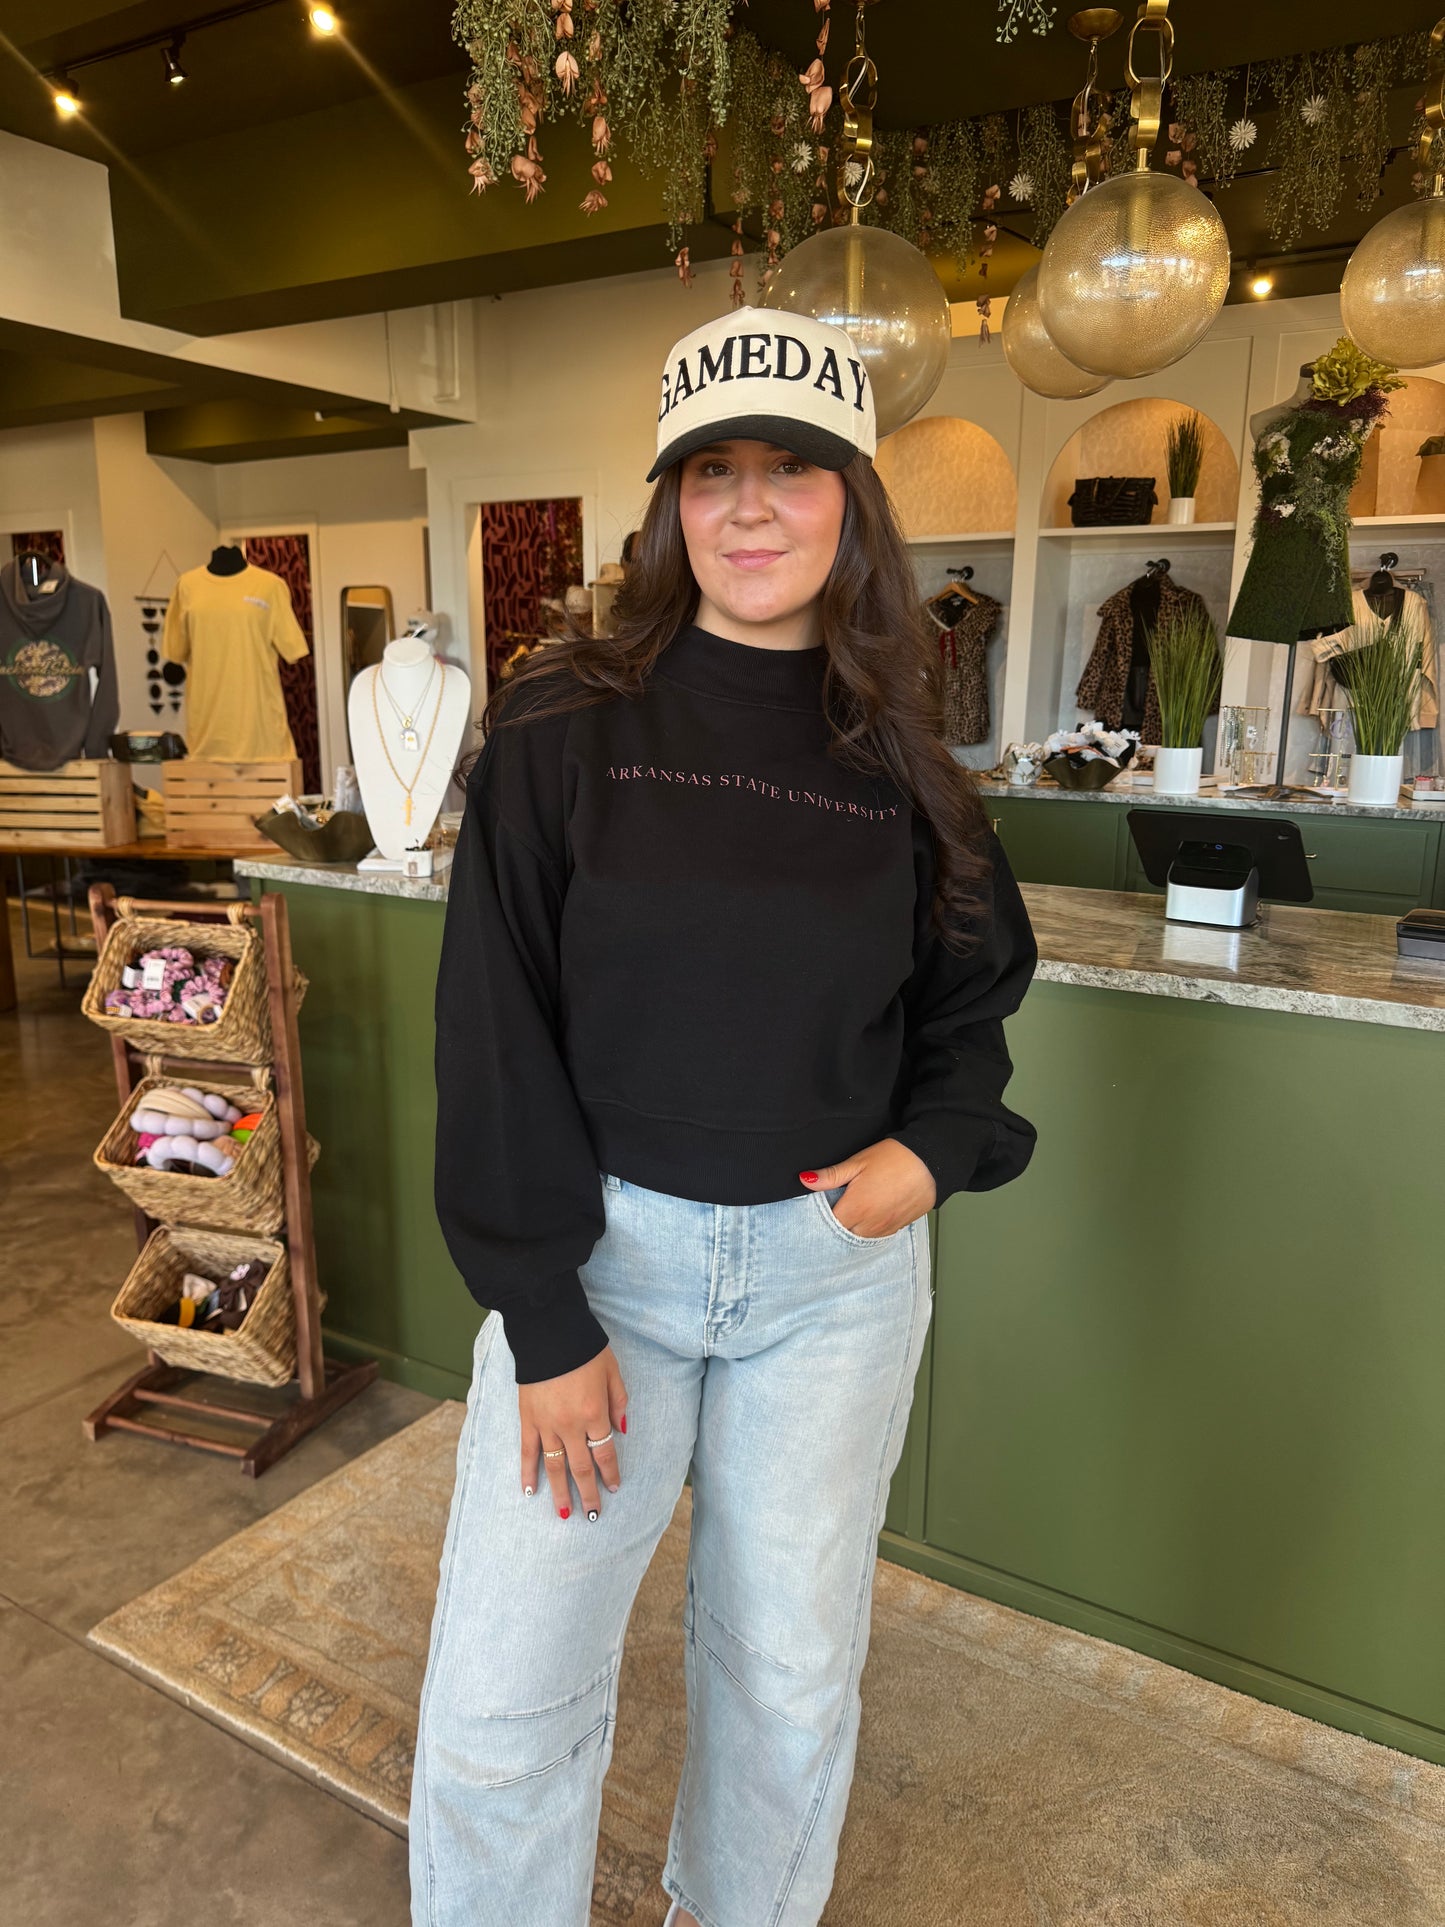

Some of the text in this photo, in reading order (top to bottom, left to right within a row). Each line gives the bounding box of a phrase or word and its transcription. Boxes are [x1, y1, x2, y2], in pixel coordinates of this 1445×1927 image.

[658, 333, 868, 424] GAMEDAY
[606, 765, 898, 820] ARKANSAS STATE UNIVERSITY
